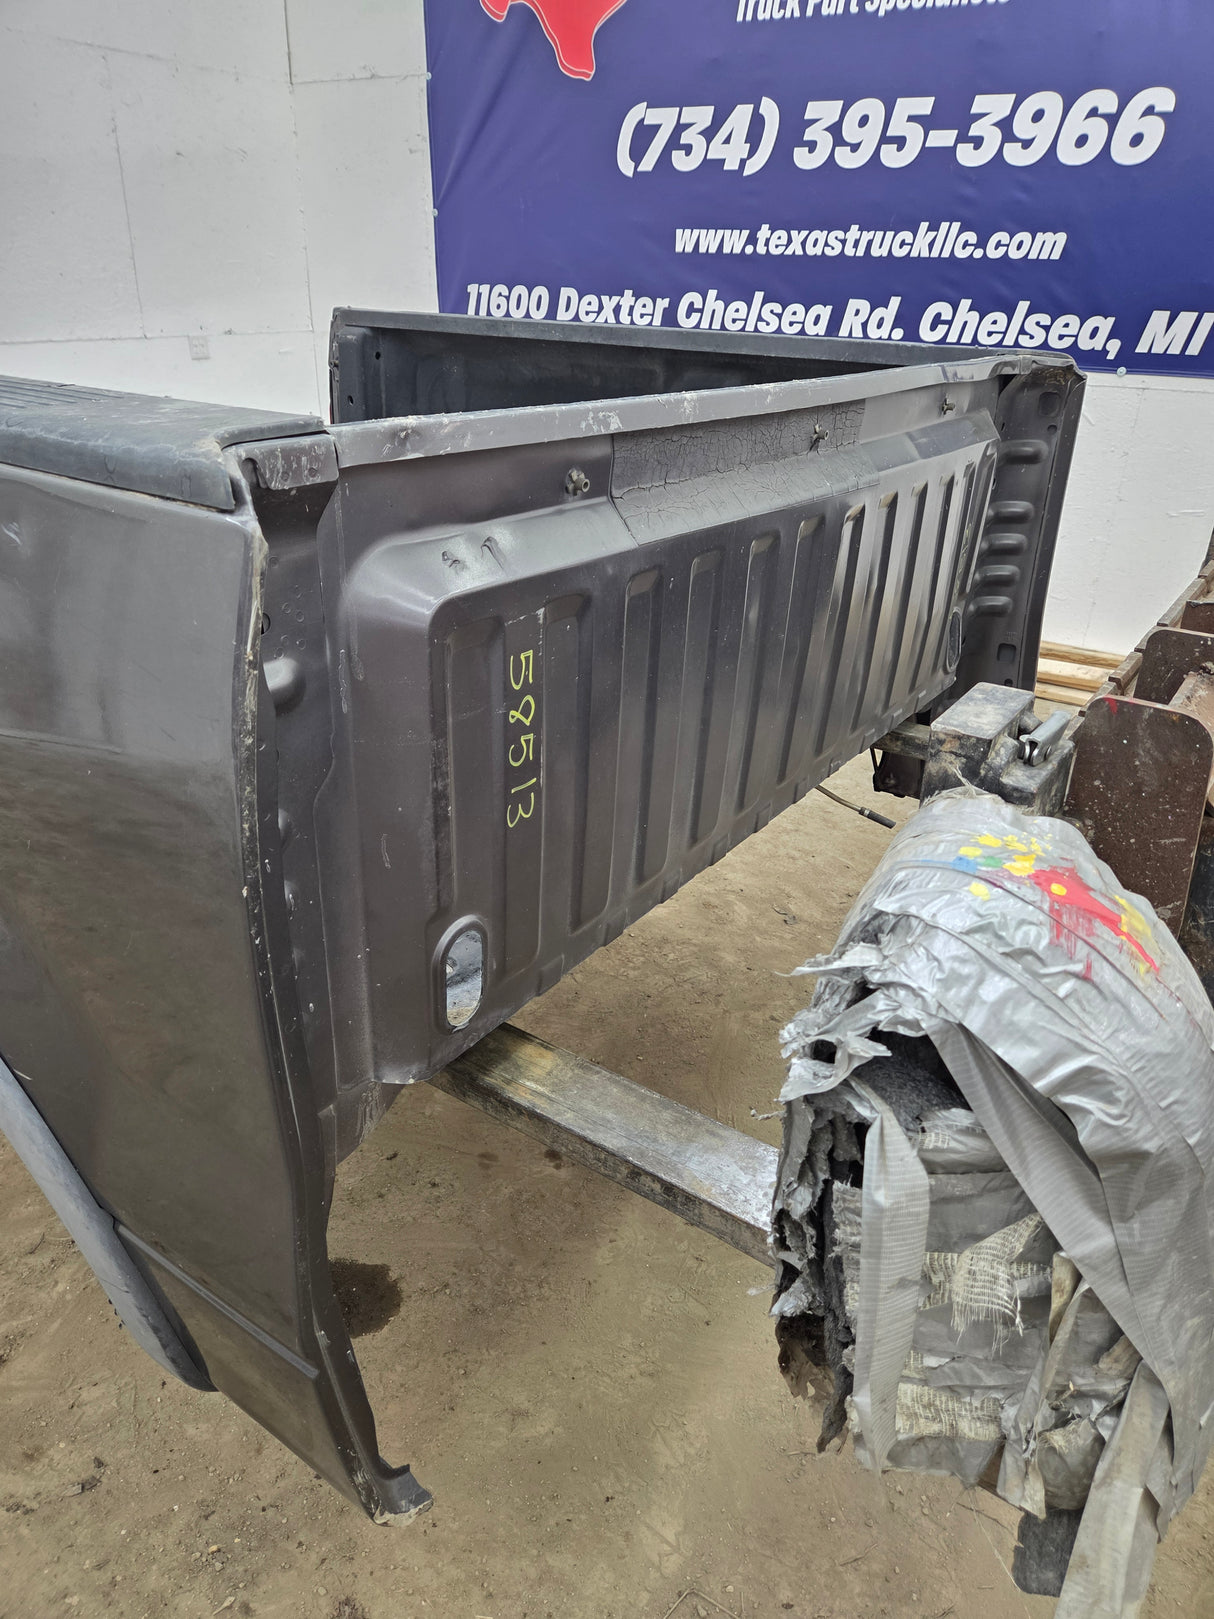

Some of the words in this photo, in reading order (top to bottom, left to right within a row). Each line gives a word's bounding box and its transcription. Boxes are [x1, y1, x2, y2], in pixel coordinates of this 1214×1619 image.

[617, 96, 780, 178] (734)
[793, 87, 1176, 170] 395-3966
[675, 221, 1067, 260] www.texastruckllc.com
[467, 283, 549, 320] 11600
[556, 287, 670, 326] Dexter
[676, 289, 832, 336] Chelsea
[838, 296, 905, 340] Rd.
[918, 298, 1122, 360] Chelsea,
[1135, 310, 1214, 356] MI
[507, 649, 536, 828] 58513
